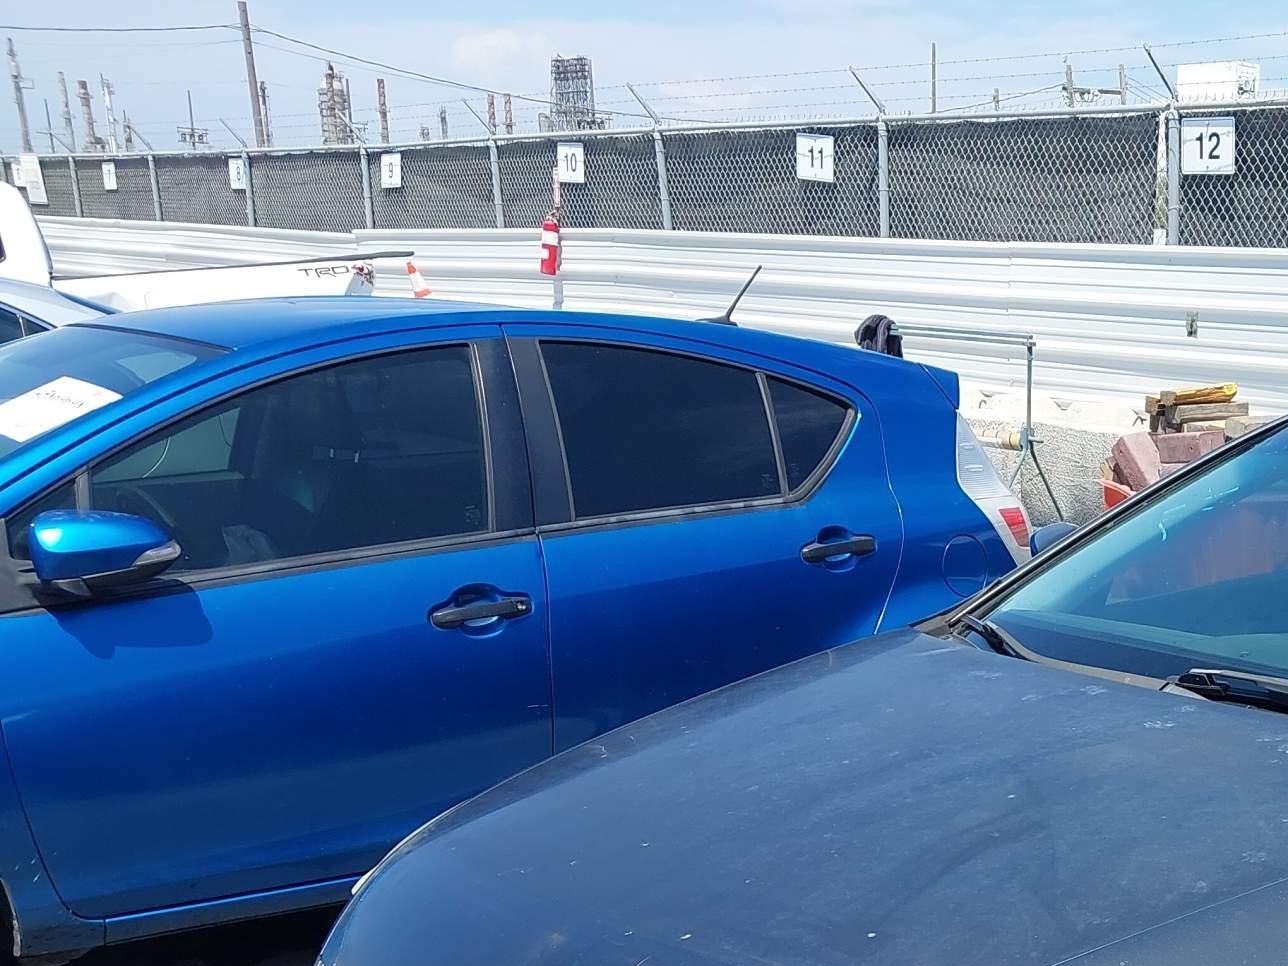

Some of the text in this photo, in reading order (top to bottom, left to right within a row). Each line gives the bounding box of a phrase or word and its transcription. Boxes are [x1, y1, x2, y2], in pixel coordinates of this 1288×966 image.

[1195, 131, 1221, 160] 12
[564, 152, 577, 173] 10
[807, 145, 824, 170] 11
[236, 165, 241, 181] 8
[388, 161, 394, 179] 9
[297, 265, 350, 278] TRD
